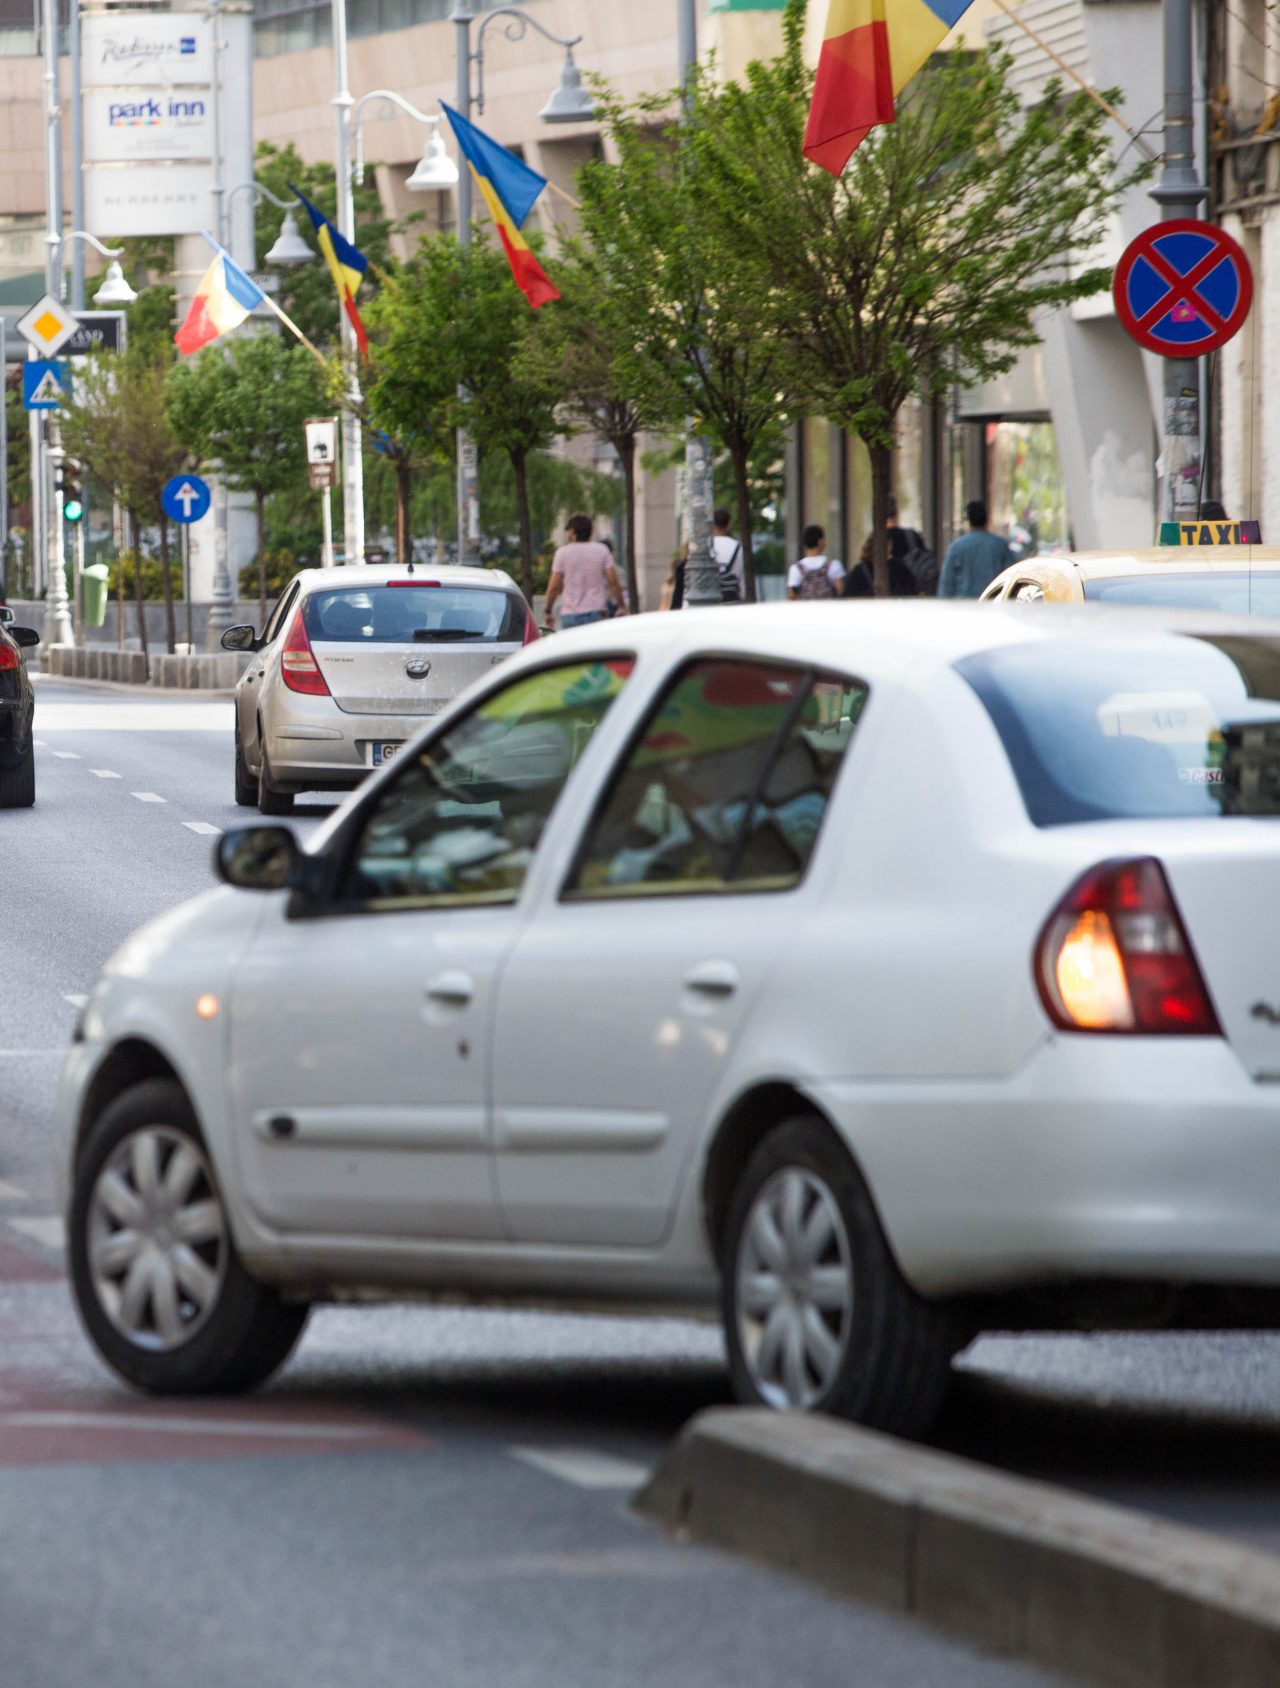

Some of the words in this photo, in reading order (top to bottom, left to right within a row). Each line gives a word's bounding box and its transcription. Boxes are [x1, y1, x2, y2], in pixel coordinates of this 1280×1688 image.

[110, 97, 161, 125] park
[168, 97, 204, 116] inn
[1182, 525, 1240, 545] TAXI
